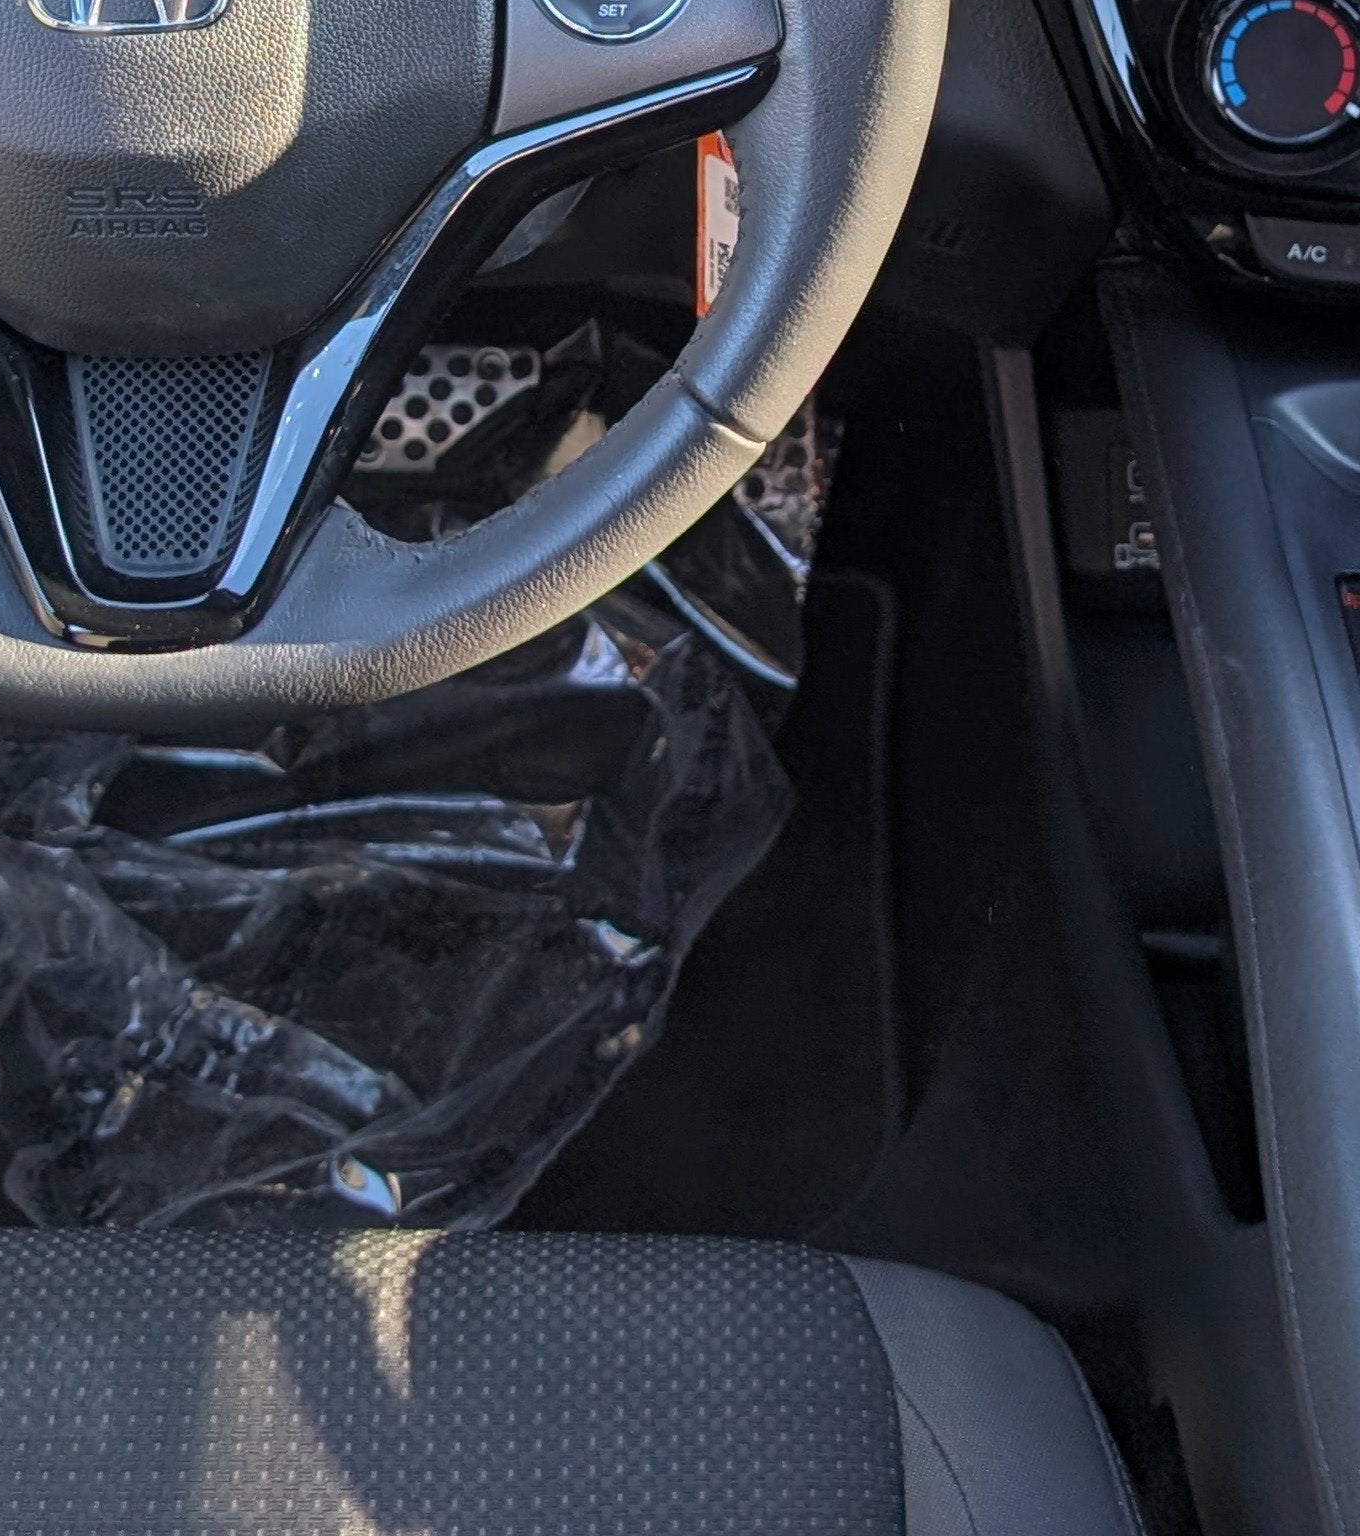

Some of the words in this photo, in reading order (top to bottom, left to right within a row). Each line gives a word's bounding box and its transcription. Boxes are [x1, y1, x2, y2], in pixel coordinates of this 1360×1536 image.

[597, 4, 628, 17] SET
[66, 185, 204, 213] SRS
[67, 217, 209, 239] AIRBAG
[1286, 242, 1327, 265] A/C
